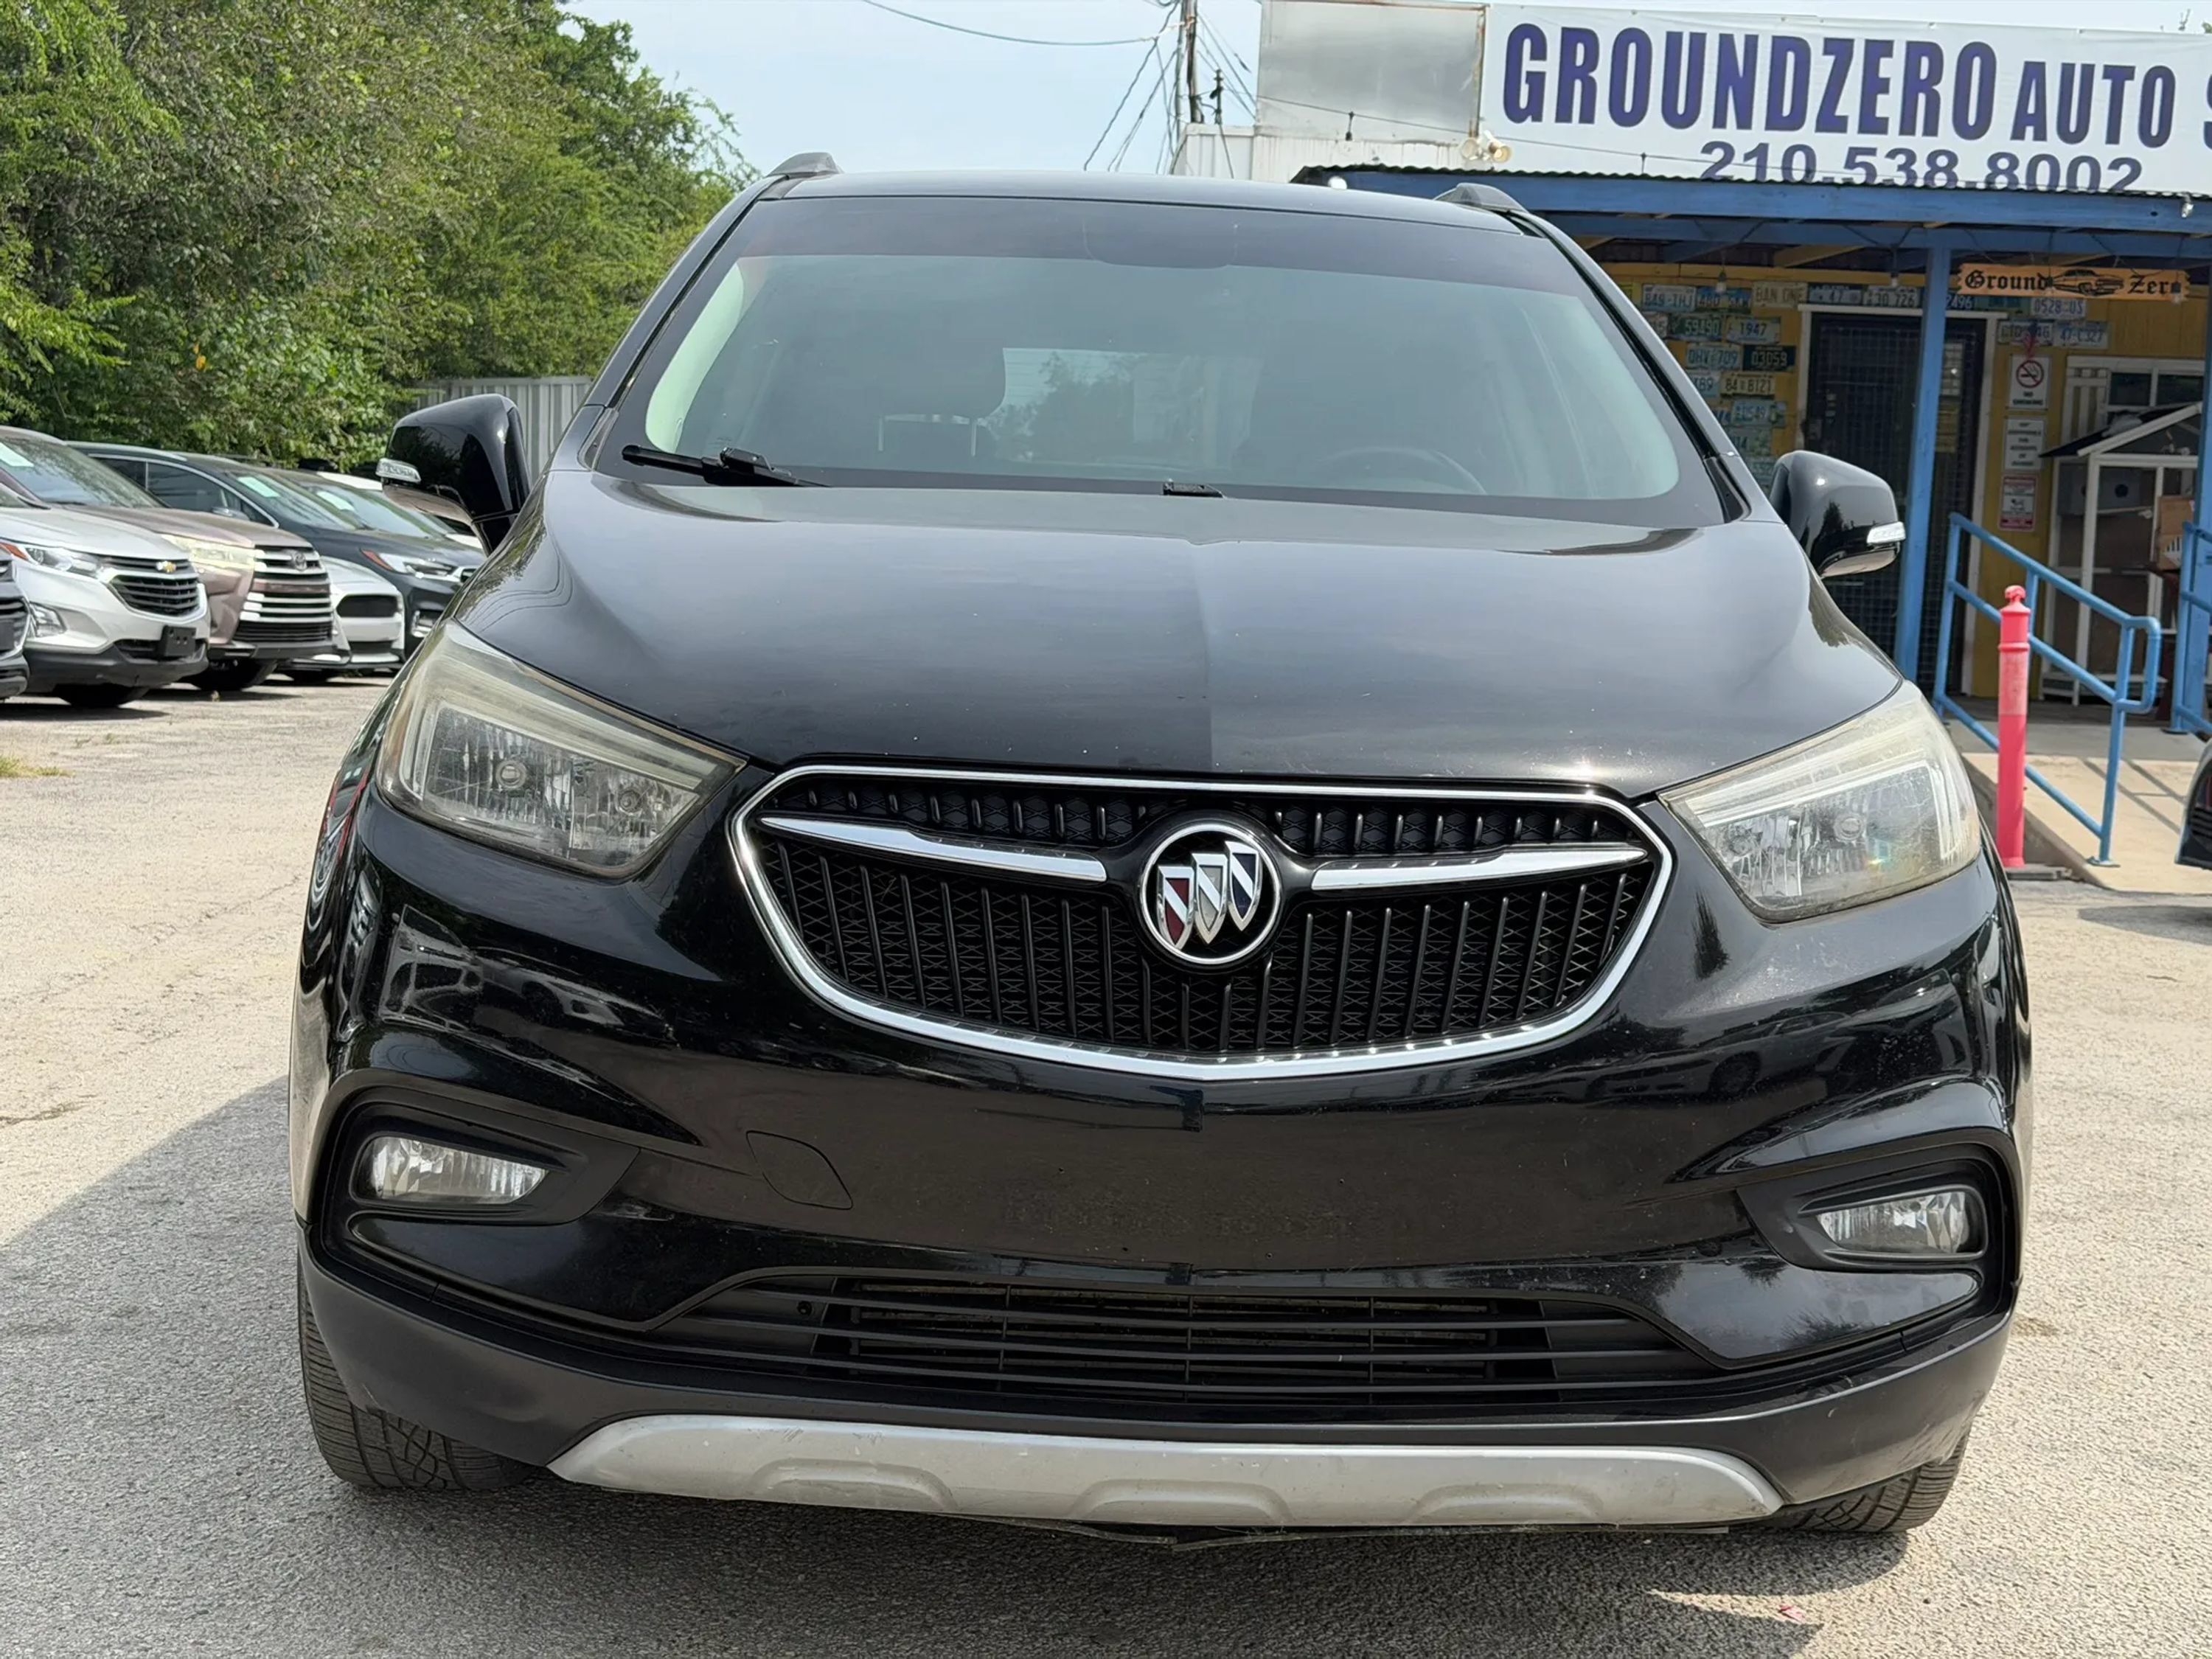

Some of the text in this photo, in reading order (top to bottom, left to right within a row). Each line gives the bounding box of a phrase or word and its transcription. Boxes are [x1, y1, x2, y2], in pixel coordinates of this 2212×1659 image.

[1503, 23, 1997, 141] GROUNDZERO
[2010, 62, 2176, 148] AUTO
[1964, 268, 2050, 291] Ground
